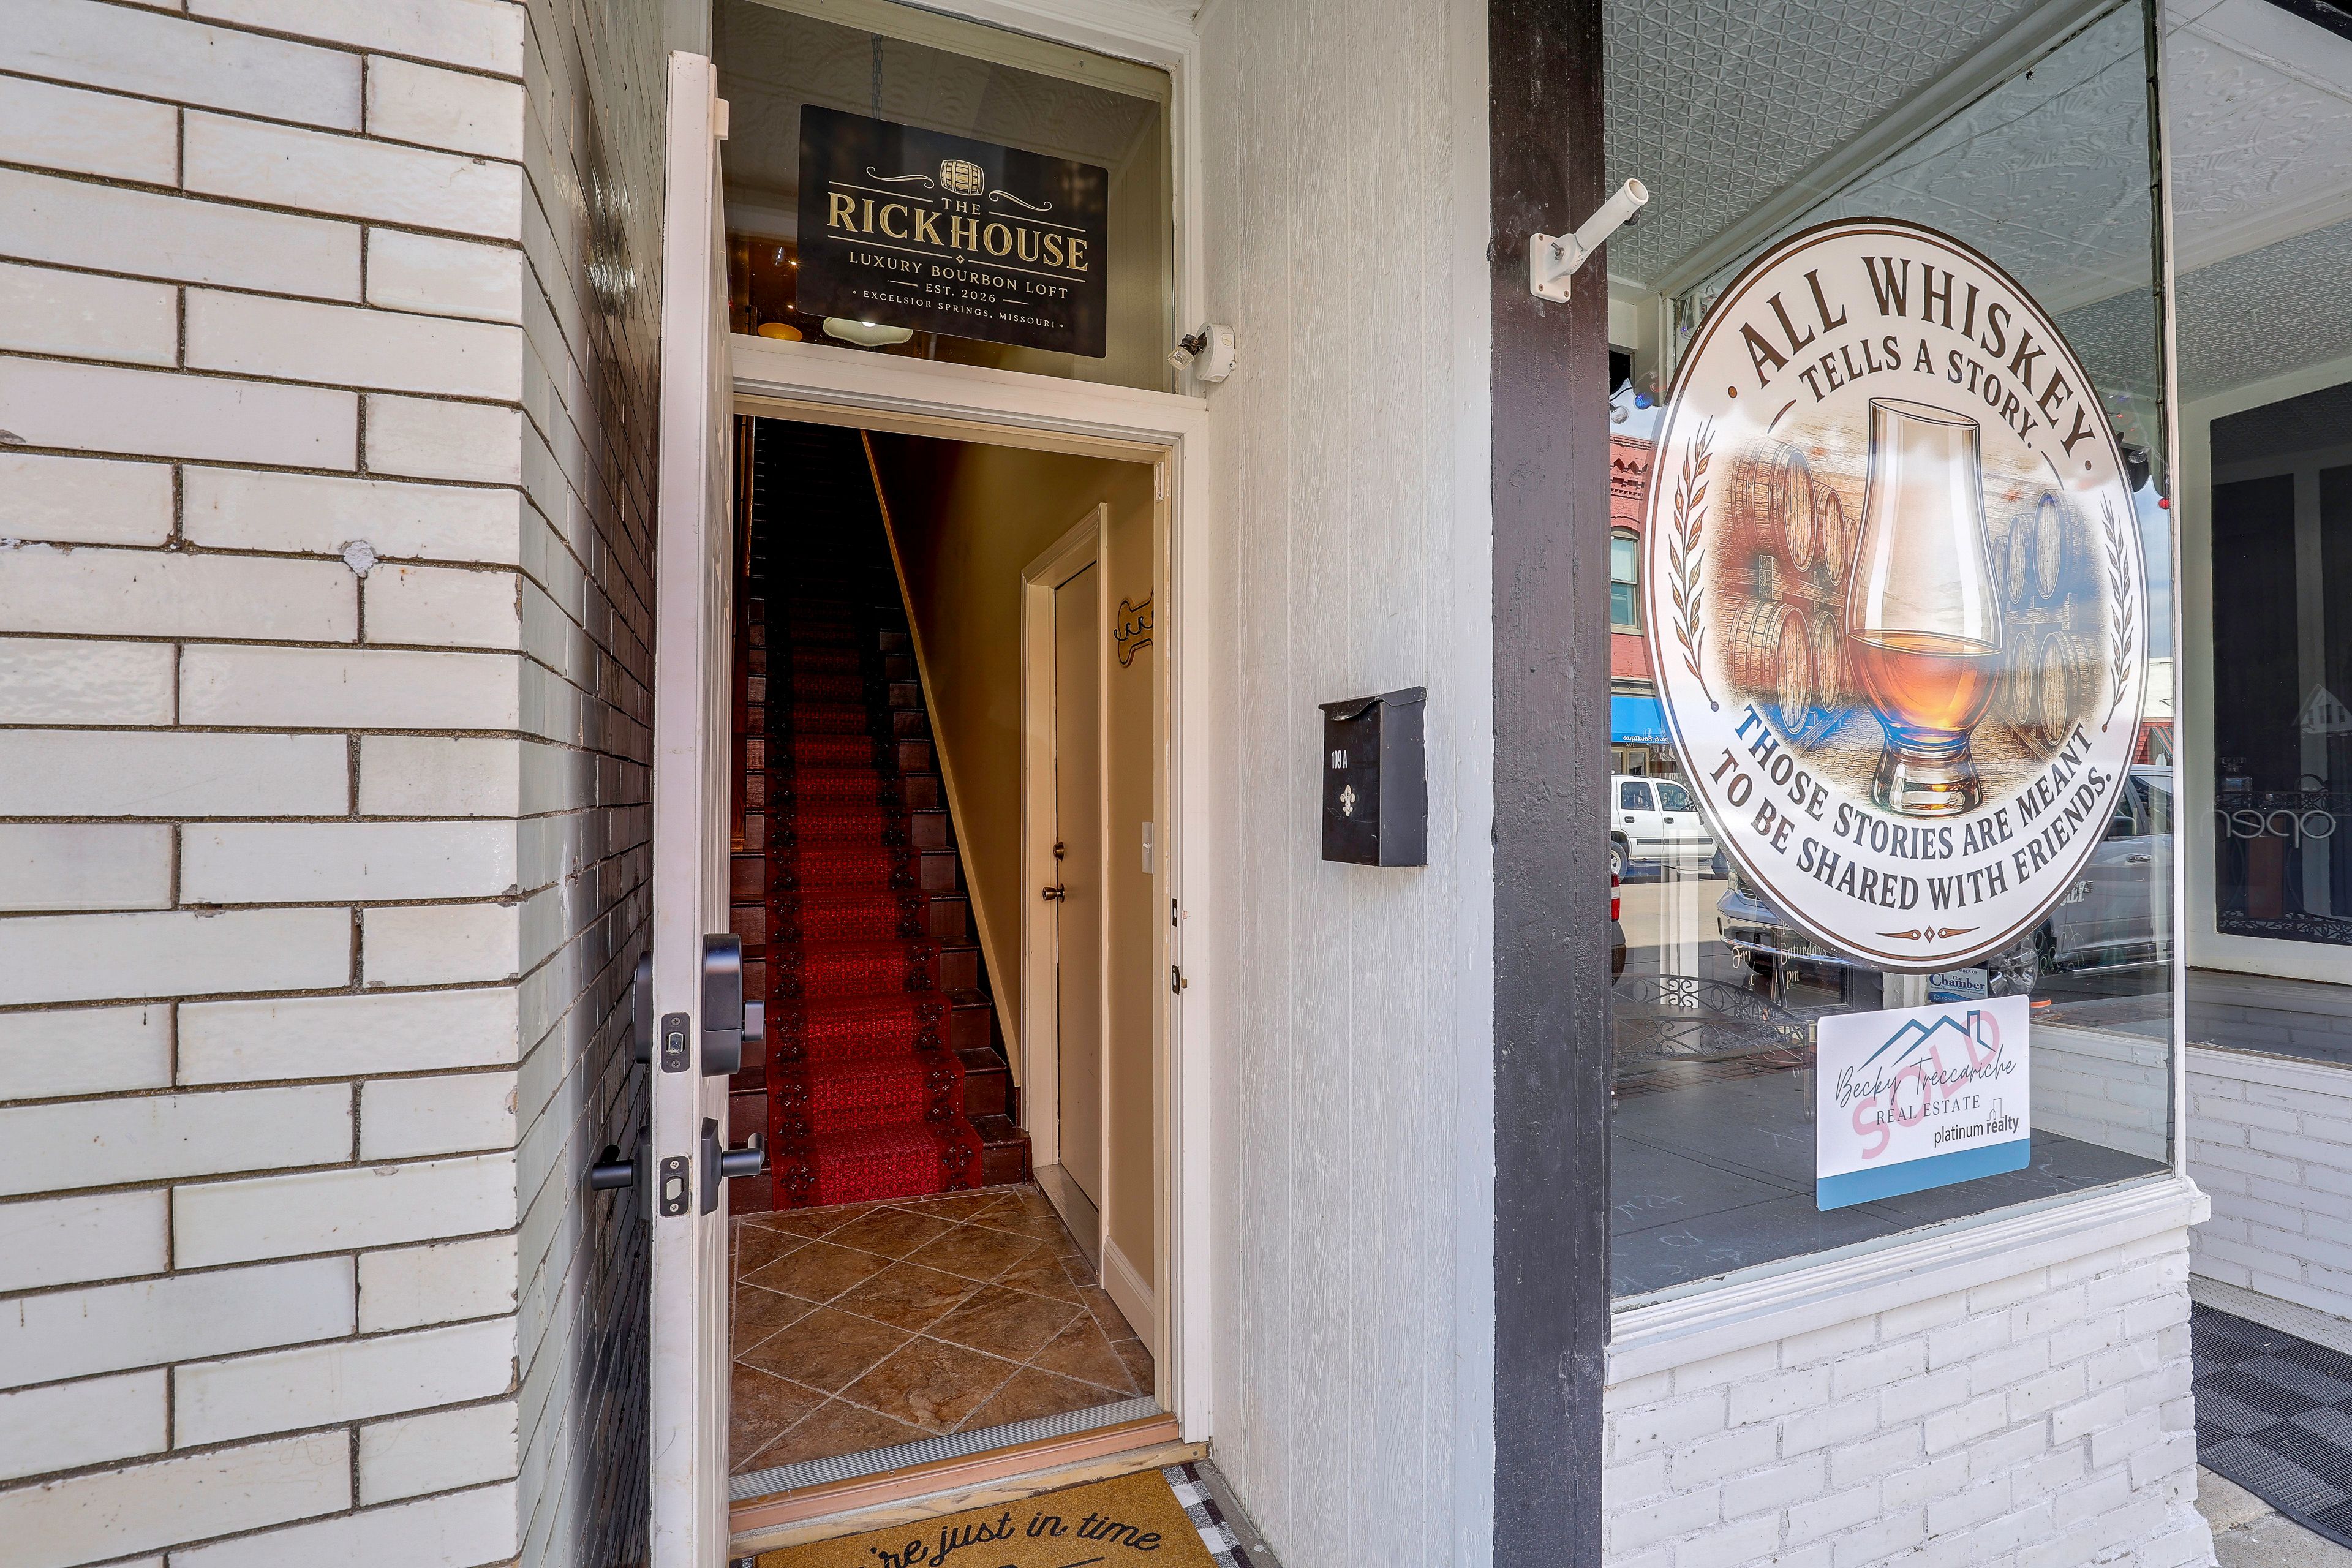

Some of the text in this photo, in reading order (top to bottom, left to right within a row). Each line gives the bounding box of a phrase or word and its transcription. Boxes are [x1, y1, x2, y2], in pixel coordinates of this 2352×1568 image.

[827, 191, 1088, 272] RICKHOUSE
[941, 197, 981, 216] THE
[849, 251, 1068, 299] LUXURY BOURBON LOFT
[925, 283, 997, 303] EST. 2026
[863, 290, 1055, 328] EXCELSIOR SPRINGS, MISSOURI
[1739, 256, 2097, 460] ALL WHISKEY
[1798, 335, 2039, 450] TELLS A STORY.
[1332, 750, 1348, 769] 109 A
[1735, 703, 2093, 861] THOSE STORIES ARE MEANT
[1709, 748, 1753, 808] TO
[1751, 799, 1795, 855] BE
[1796, 835, 1919, 911] SHARED
[1927, 863, 2008, 911] WITH
[1929, 973, 1986, 990] Chamber
[1835, 1043, 2016, 1108] Becky Treccariche
[1852, 1010, 2000, 1160] SOLD
[1875, 1095, 1981, 1125] REAL ESTATE
[1934, 1115, 2019, 1148] platinum realty
[929, 1511, 1014, 1567] just
[1027, 1511, 1067, 1538] in
[1077, 1512, 1162, 1551] time
